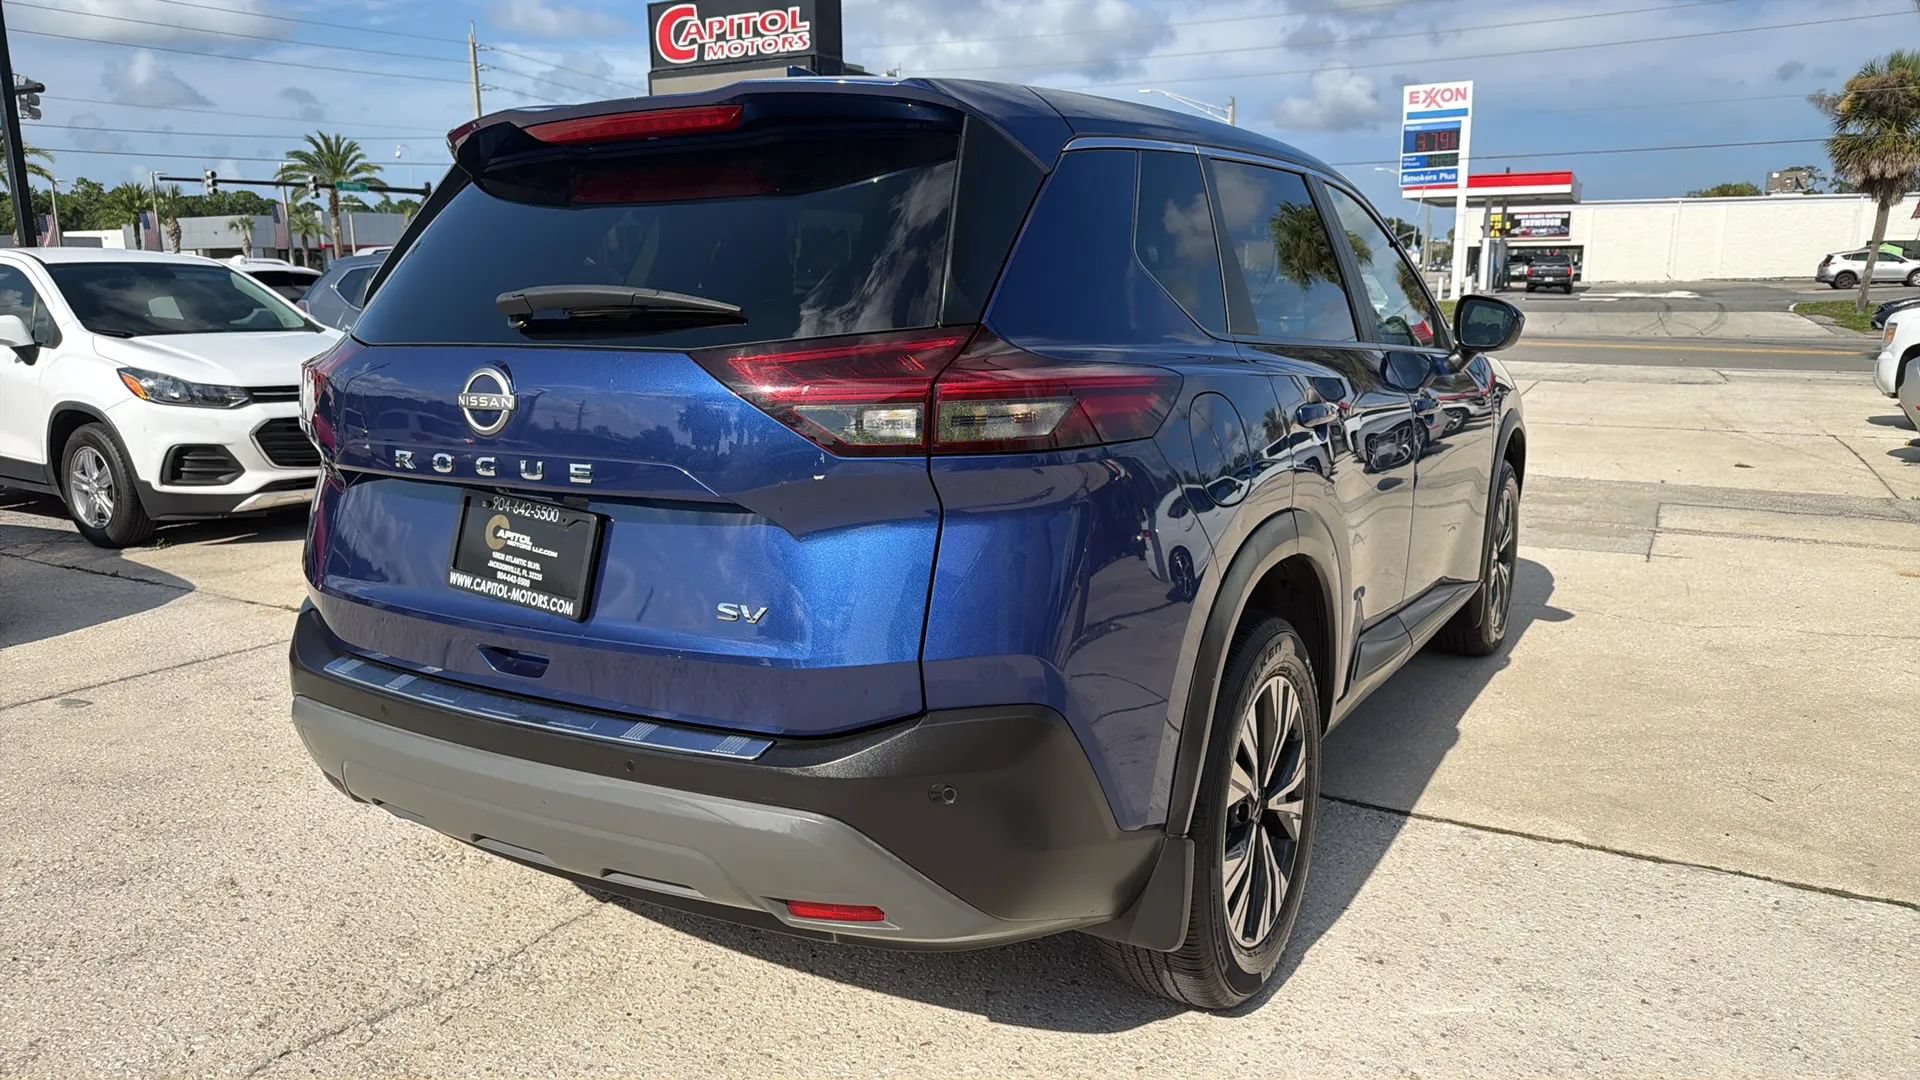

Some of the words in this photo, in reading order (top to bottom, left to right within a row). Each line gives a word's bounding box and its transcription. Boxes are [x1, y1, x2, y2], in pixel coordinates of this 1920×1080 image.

[656, 4, 810, 63] CAPITOL
[704, 32, 810, 60] MOTORS
[1408, 86, 1468, 108] EXXON
[1402, 173, 1437, 183] Smokers
[1439, 172, 1456, 180] Plus
[458, 395, 514, 409] NISSAN
[394, 449, 594, 484] ROGUE
[492, 496, 560, 523] 904-642-5500
[485, 513, 533, 551] CAPITOL
[507, 540, 531, 551] MOTORS
[505, 555, 527, 566] ATLANTIC
[449, 571, 575, 616] WWW.CAPITOL-MOTORS.COM
[716, 602, 769, 625] SV
